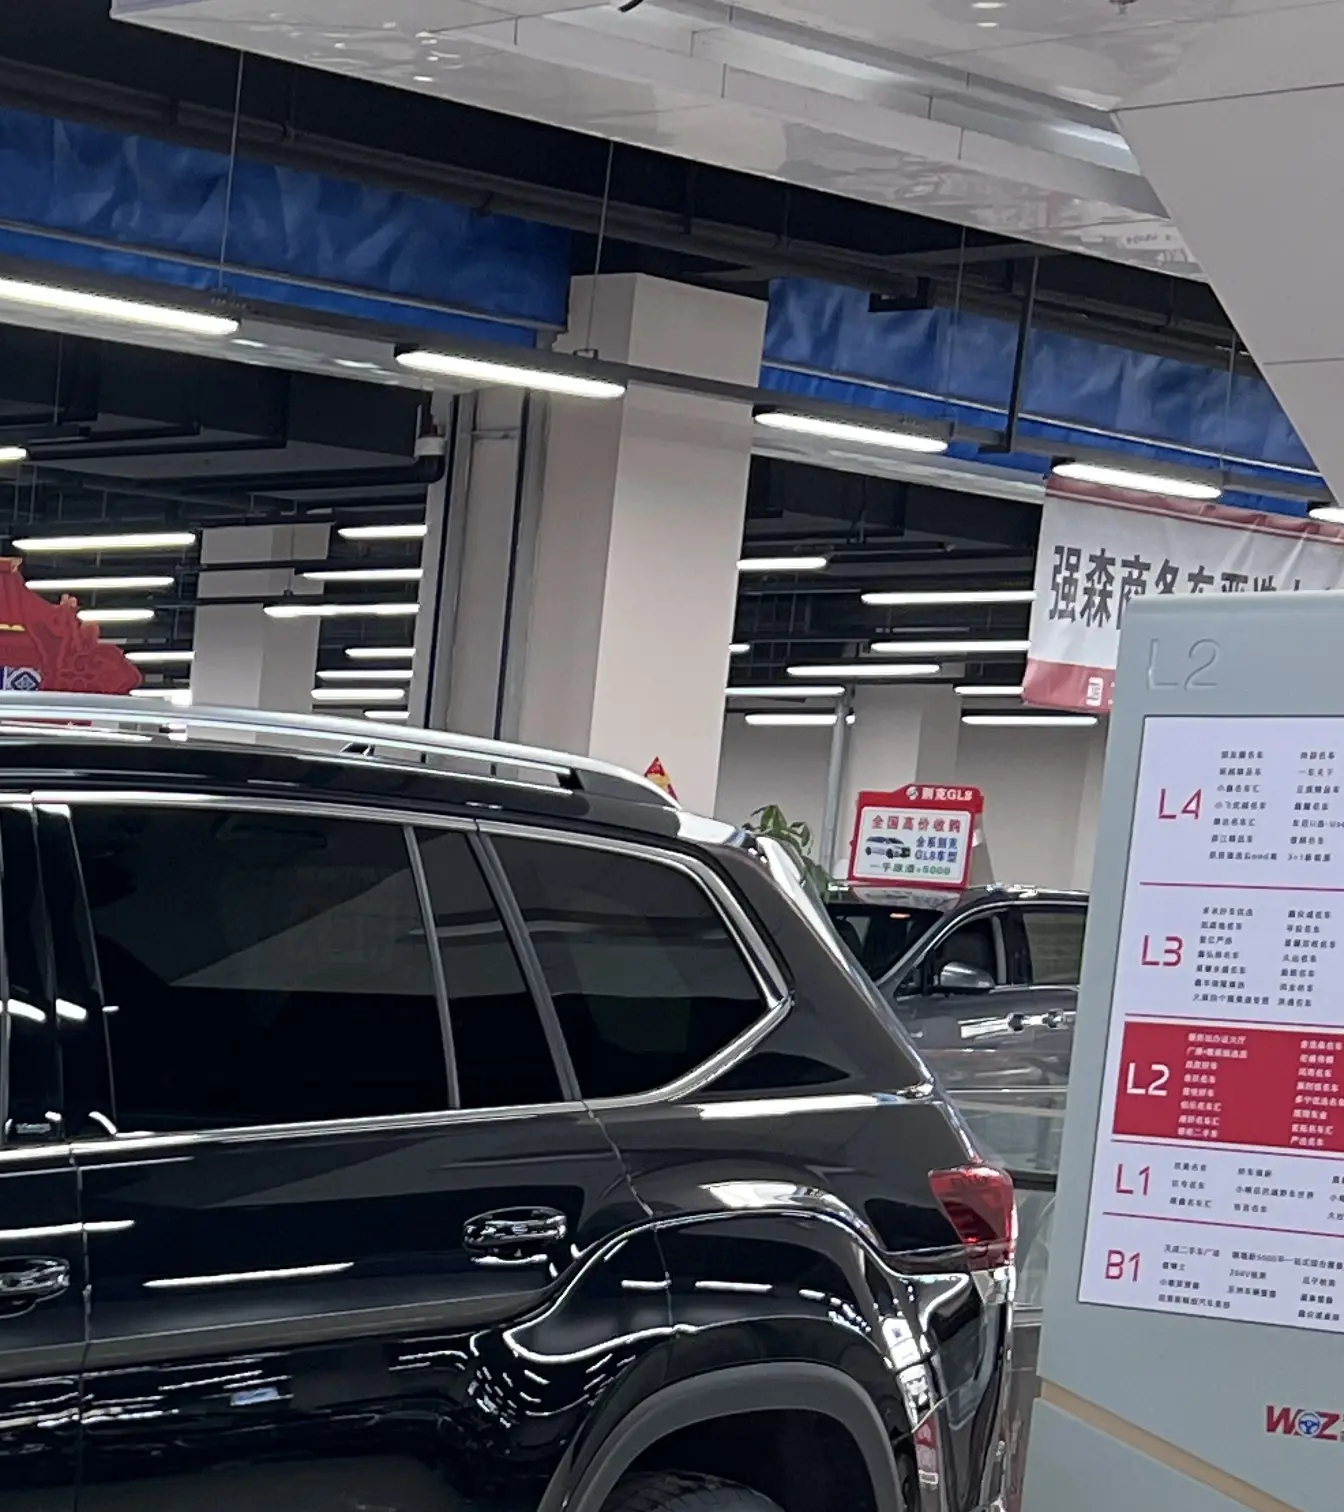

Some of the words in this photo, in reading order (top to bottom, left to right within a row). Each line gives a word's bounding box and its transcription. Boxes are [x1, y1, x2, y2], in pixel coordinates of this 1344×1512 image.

[1146, 637, 1221, 691] L2
[1159, 788, 1202, 820] L4
[872, 815, 961, 833] 全国高价收购
[1143, 935, 1183, 967] L3
[1126, 1063, 1169, 1096] L2
[1115, 1163, 1152, 1196] L1
[1105, 1249, 1141, 1283] B1
